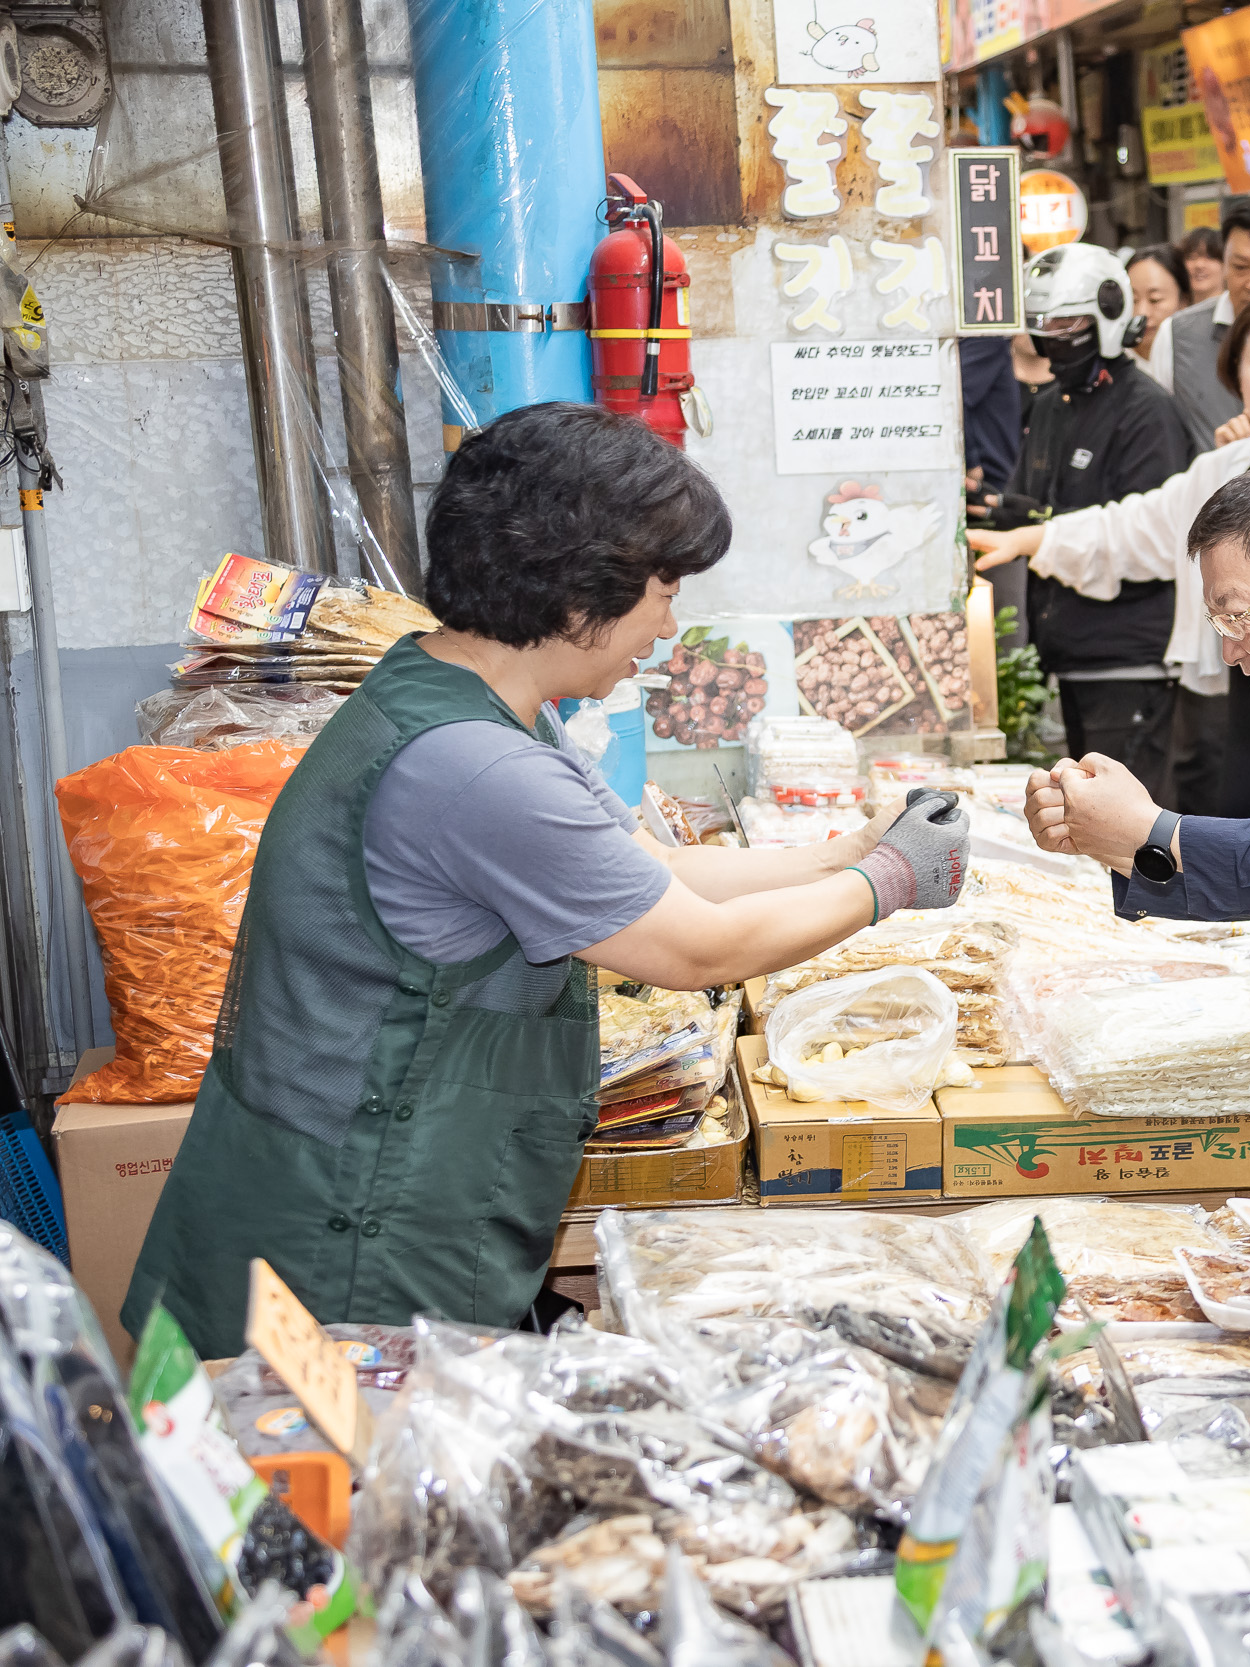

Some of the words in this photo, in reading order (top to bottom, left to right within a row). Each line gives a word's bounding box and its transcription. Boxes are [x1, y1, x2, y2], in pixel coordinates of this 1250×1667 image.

[969, 164, 1003, 322] 닭꼬치
[826, 345, 865, 359] 추억의
[871, 344, 933, 358] 옛날핫도그
[791, 387, 829, 401] 한입만
[878, 384, 942, 399] 치즈핫도그
[792, 427, 843, 441] 소세지를
[880, 424, 943, 438] 마약핫도그
[233, 571, 273, 610] 황태포
[1078, 1144, 1144, 1166] 멸치
[1149, 1141, 1195, 1161] 굴포
[957, 1165, 987, 1175] 1.5kg
[1093, 1168, 1111, 1181] 왕
[1119, 1166, 1170, 1180] 칼슘의
